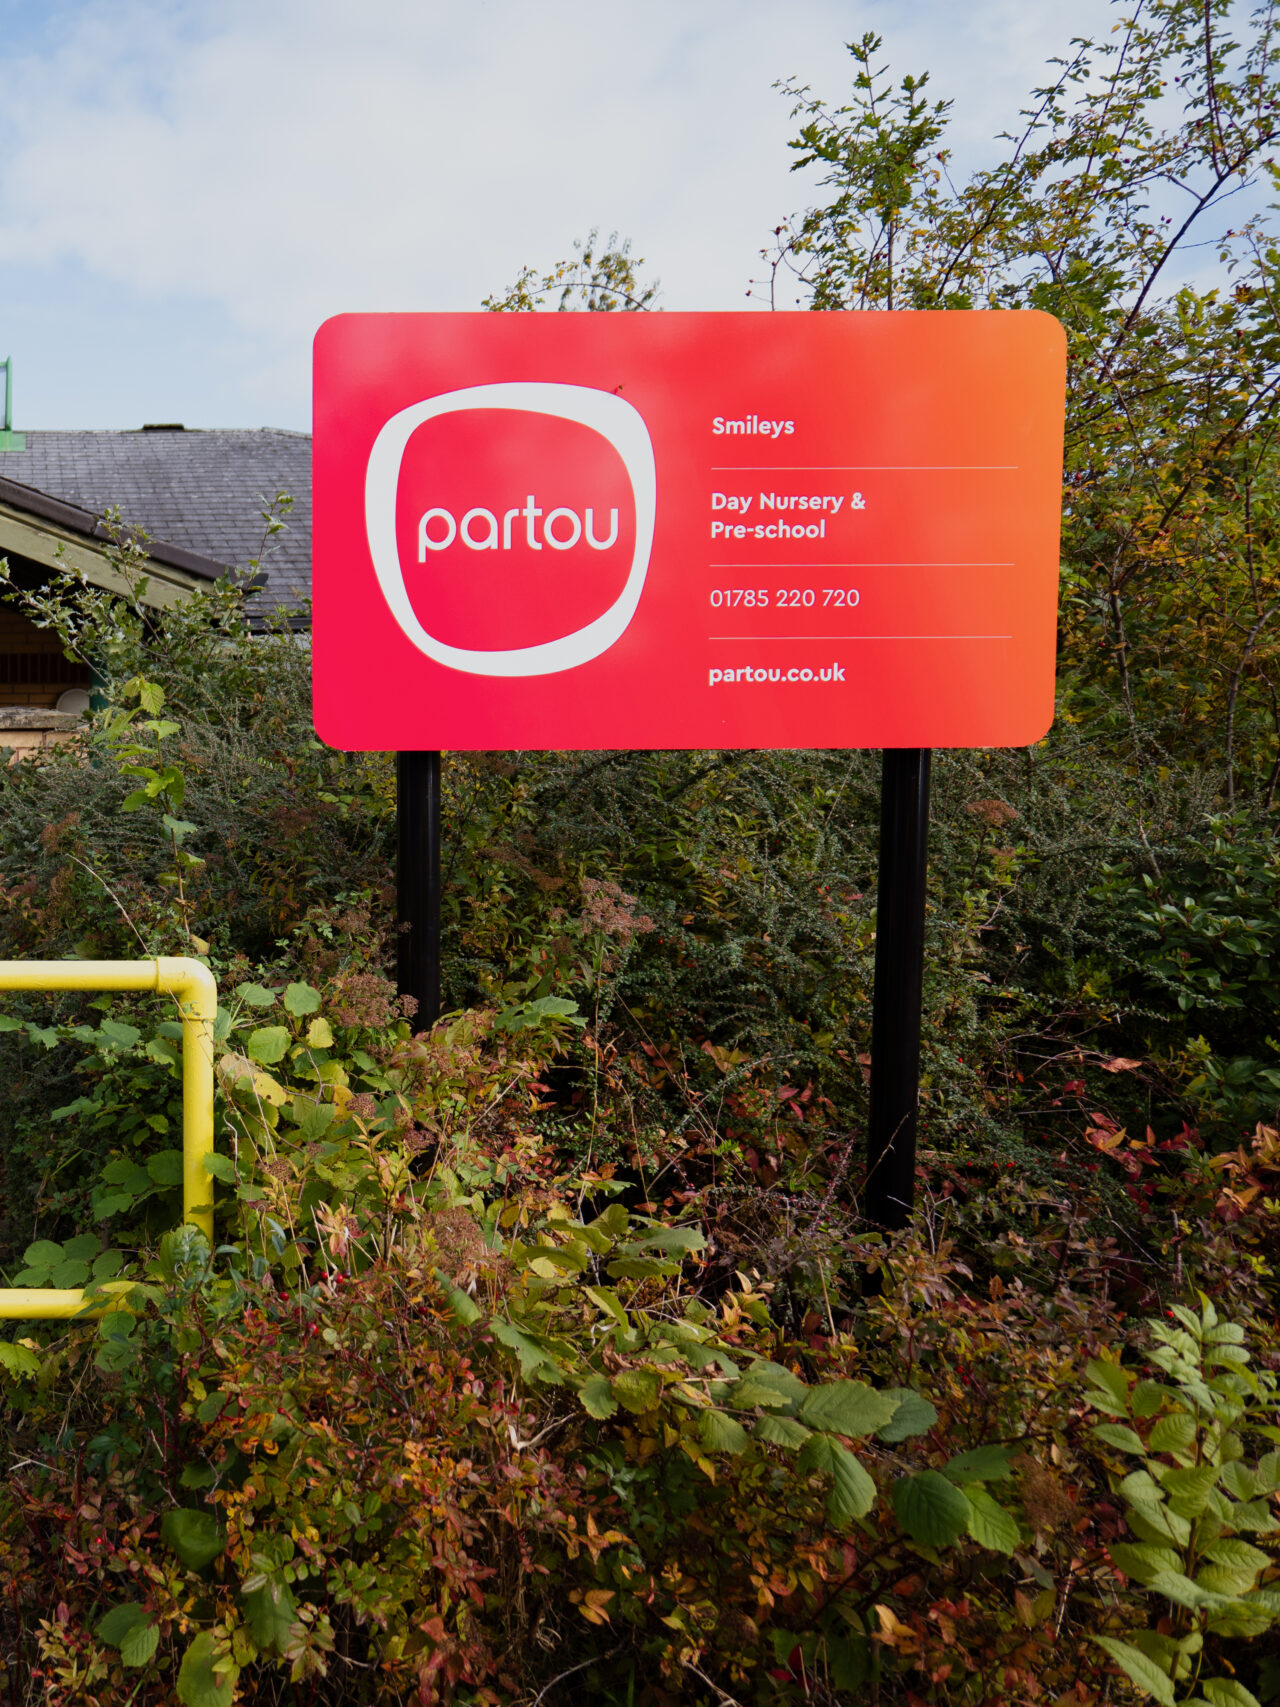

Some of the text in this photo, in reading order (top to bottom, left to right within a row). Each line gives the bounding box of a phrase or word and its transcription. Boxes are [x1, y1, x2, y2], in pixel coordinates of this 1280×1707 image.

[712, 415, 795, 439] Smileys
[711, 492, 867, 514] Day Nursery &
[418, 495, 619, 563] partou
[711, 518, 826, 539] Pre-school
[709, 589, 860, 607] 01785 220 720
[708, 662, 846, 686] partou.co.uk
